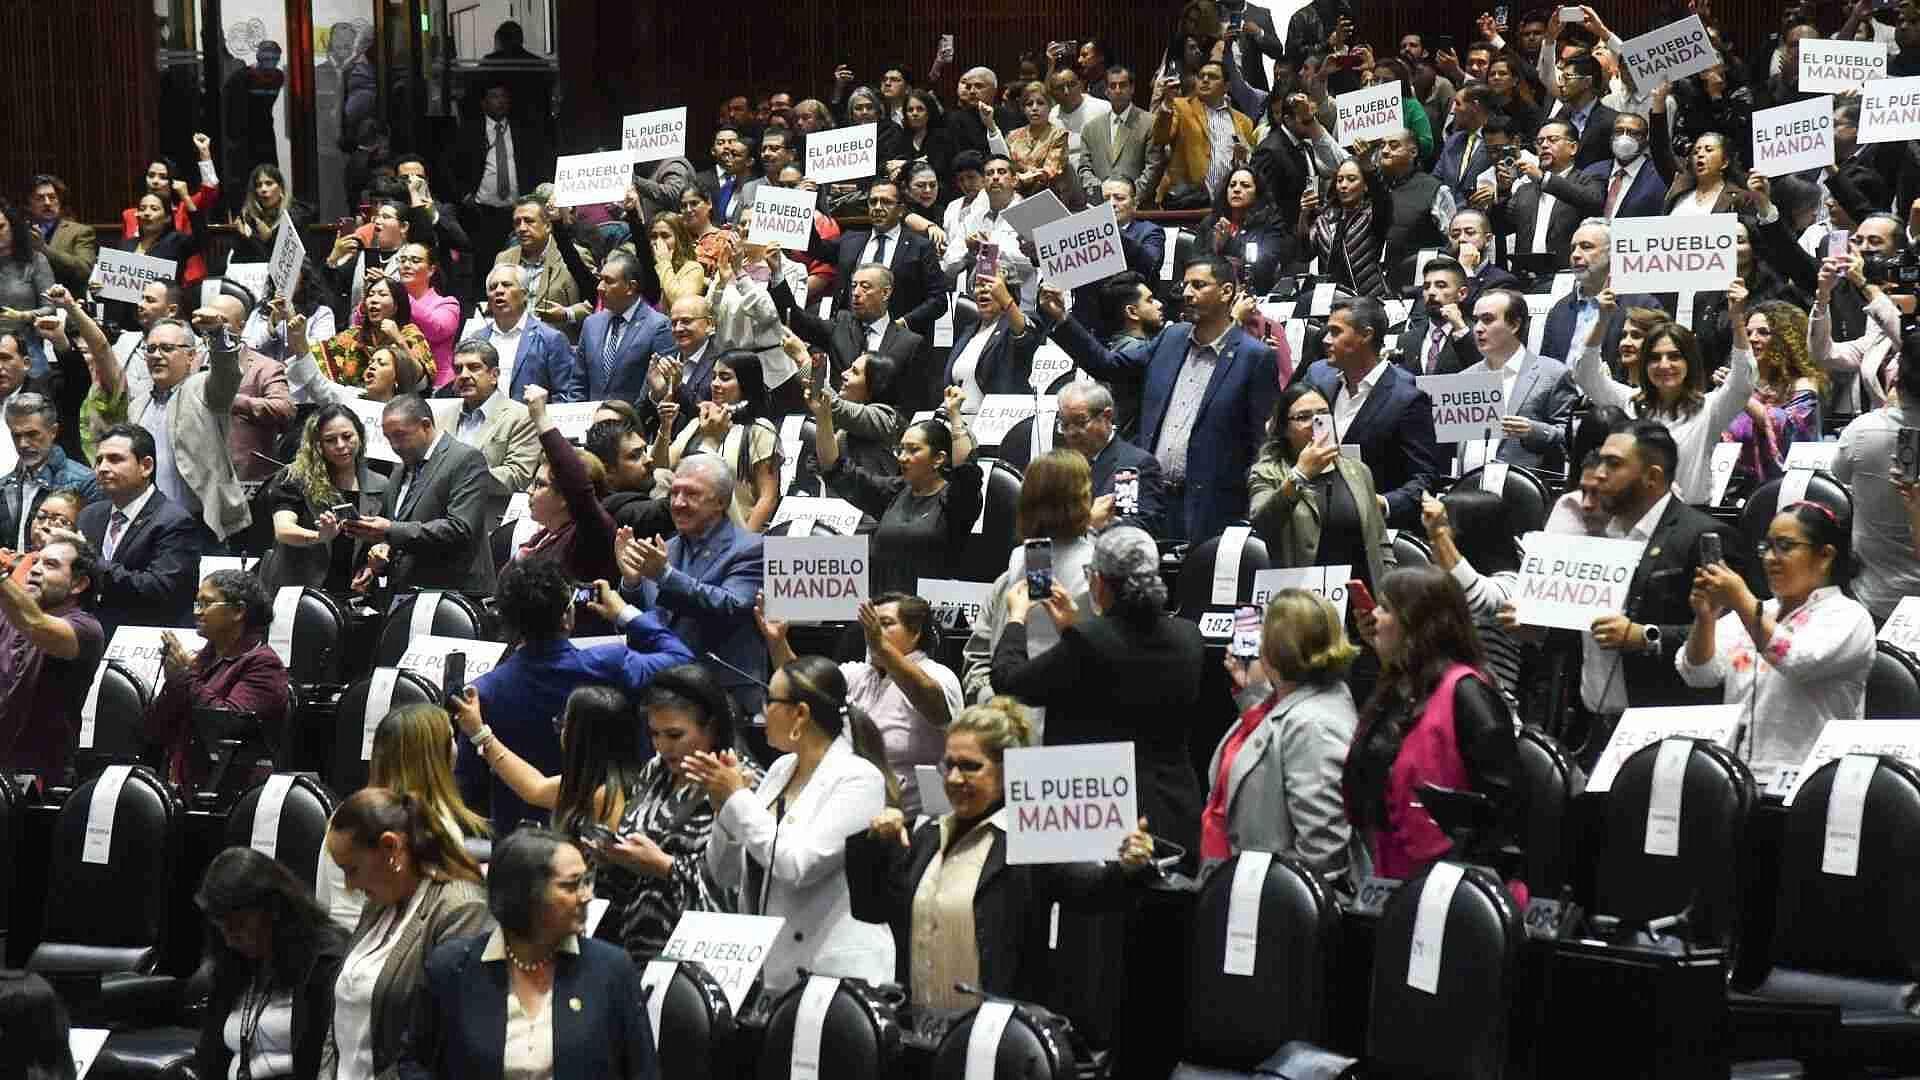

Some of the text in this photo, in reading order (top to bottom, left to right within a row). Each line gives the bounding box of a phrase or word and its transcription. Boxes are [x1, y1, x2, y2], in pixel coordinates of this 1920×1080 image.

[1627, 31, 1703, 66] EL PUEBLO
[1638, 43, 1706, 78] MANDA
[1803, 53, 1884, 67] EL PUEBLO
[1339, 96, 1399, 120] EL PUEBLO
[1865, 93, 1920, 109] EL PUE
[1343, 109, 1398, 134] MANDA
[1868, 109, 1920, 126] MAN
[624, 120, 683, 139] EL PUEBLO
[1756, 115, 1830, 143] EL PUEBLO
[627, 134, 680, 150] MANDA
[808, 138, 874, 158] EL PUEBLO
[1760, 132, 1826, 161] MANDA
[812, 150, 869, 170] MANDA
[559, 163, 630, 181] EL PUEBLO
[561, 176, 625, 192] MANDA
[755, 202, 811, 220] EL PUEBLO
[756, 216, 805, 235] MANDA
[1040, 222, 1114, 260] EL PUEBLO
[1616, 235, 1732, 253] EL PUEBLO
[100, 262, 115, 273] EL
[1048, 240, 1115, 277] MANDA
[1623, 252, 1726, 273] MANDA
[1034, 360, 1070, 370] EBLO
[1441, 390, 1501, 407] PUEBLO
[768, 559, 864, 576] EL PUEBLO
[1526, 558, 1627, 584] EL PUEBLO
[774, 578, 859, 599] MANDA
[1523, 577, 1612, 609] MANDA
[1206, 618, 1232, 633] 182
[108, 645, 126, 658] EL
[402, 653, 421, 667] EL
[1010, 776, 1129, 801] EL PUEBLO
[1018, 801, 1124, 833] MANDA
[671, 939, 763, 962] EL PUEBLO
